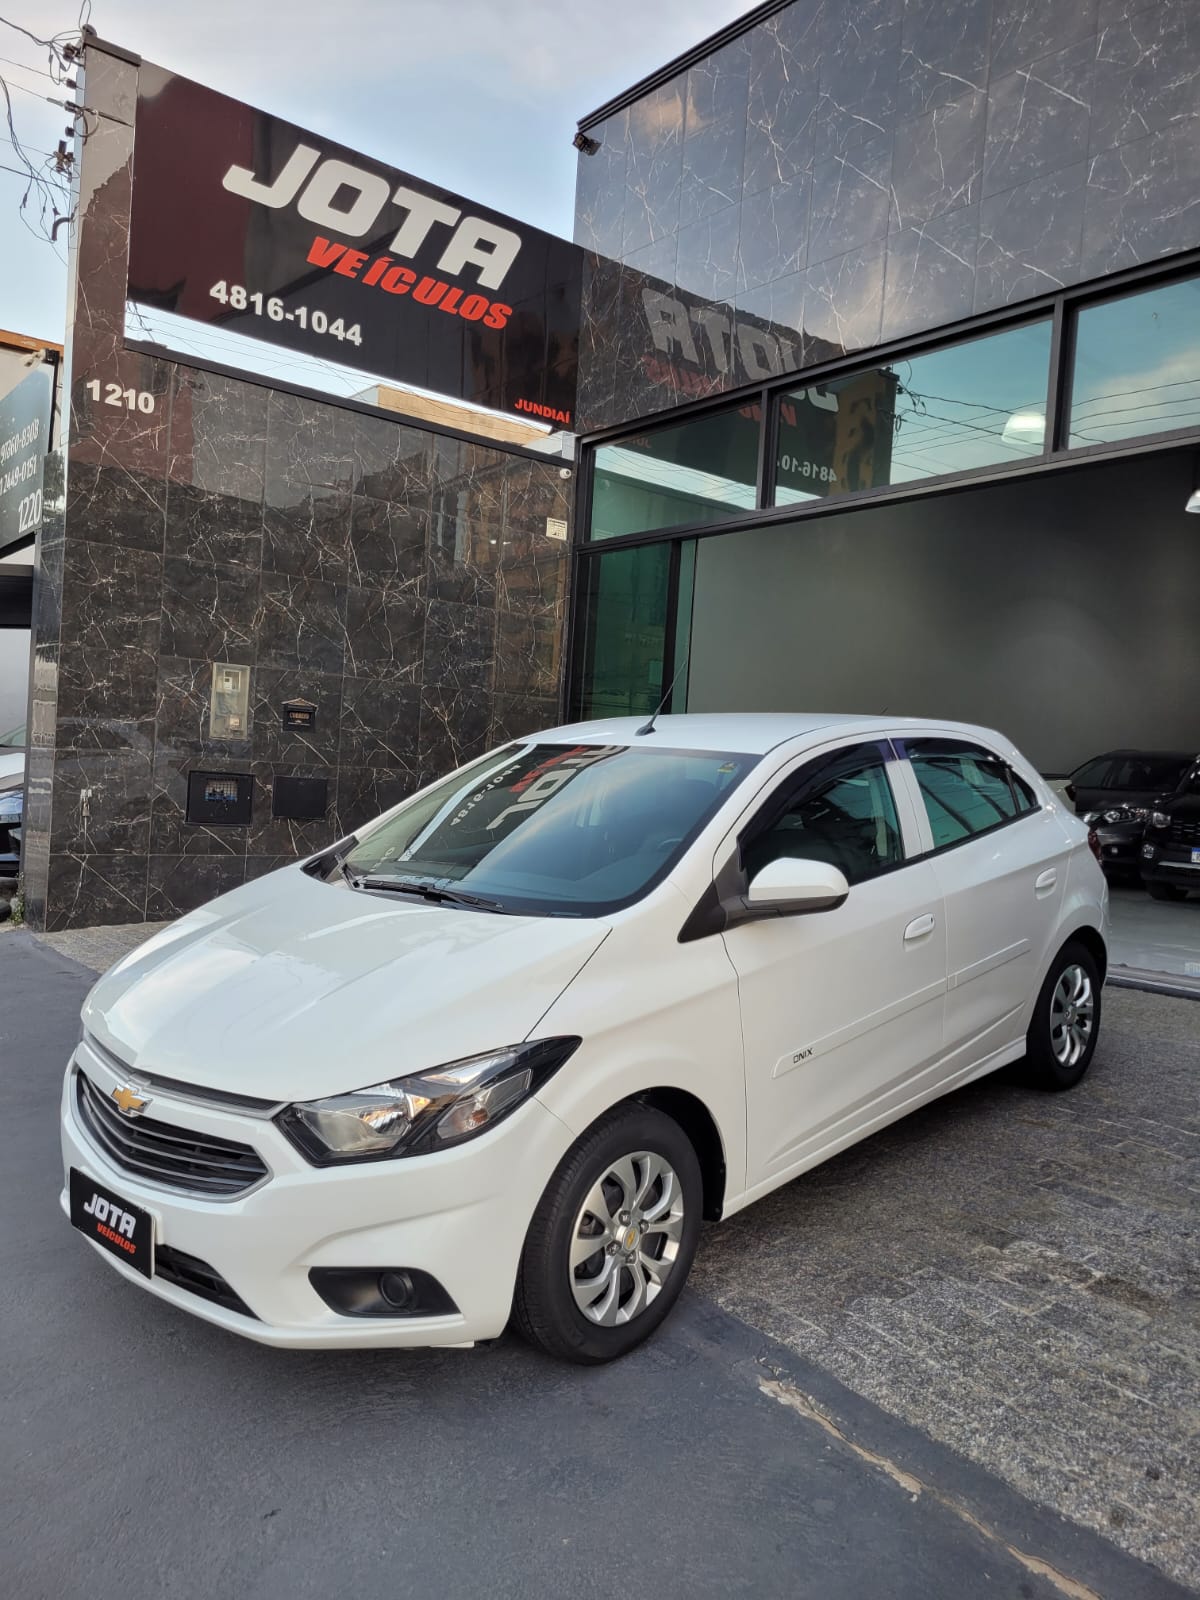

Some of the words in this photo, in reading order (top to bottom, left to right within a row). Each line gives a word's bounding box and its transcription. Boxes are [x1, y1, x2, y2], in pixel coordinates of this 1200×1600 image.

[222, 144, 522, 290] JOTA
[306, 237, 513, 329] VEÍCULOS
[209, 280, 363, 347] 4816-1044
[86, 379, 155, 414] 1210
[514, 398, 571, 424] JUNDIAÍ
[18, 489, 42, 533] 1220
[793, 1048, 813, 1064] ONIX
[84, 1194, 137, 1239] JOTA
